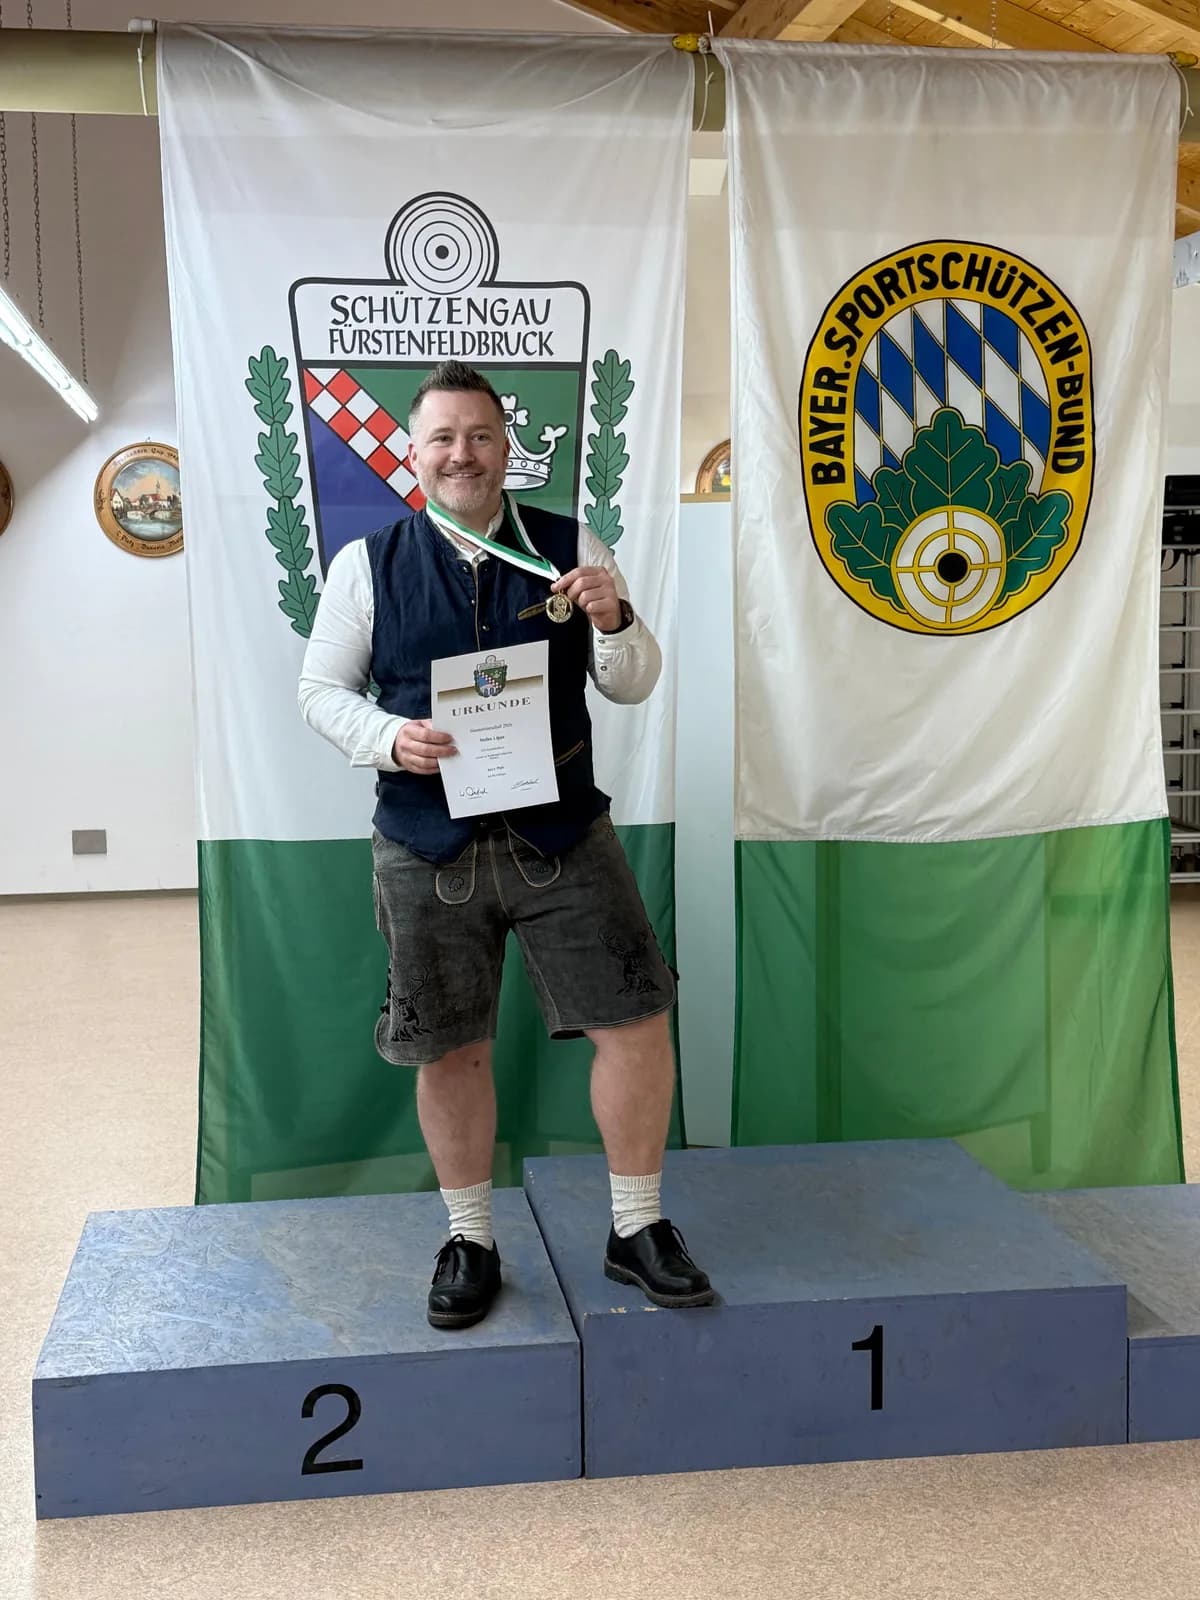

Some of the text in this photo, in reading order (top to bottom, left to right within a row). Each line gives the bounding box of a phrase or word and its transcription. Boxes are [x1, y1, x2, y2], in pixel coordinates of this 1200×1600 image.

[330, 291, 551, 326] SCHÜTZENGAU
[329, 323, 554, 357] FÜRSTENFELDBRUCK
[452, 697, 531, 717] URKUNDE
[852, 1325, 883, 1410] 1
[300, 1383, 363, 1475] 2
